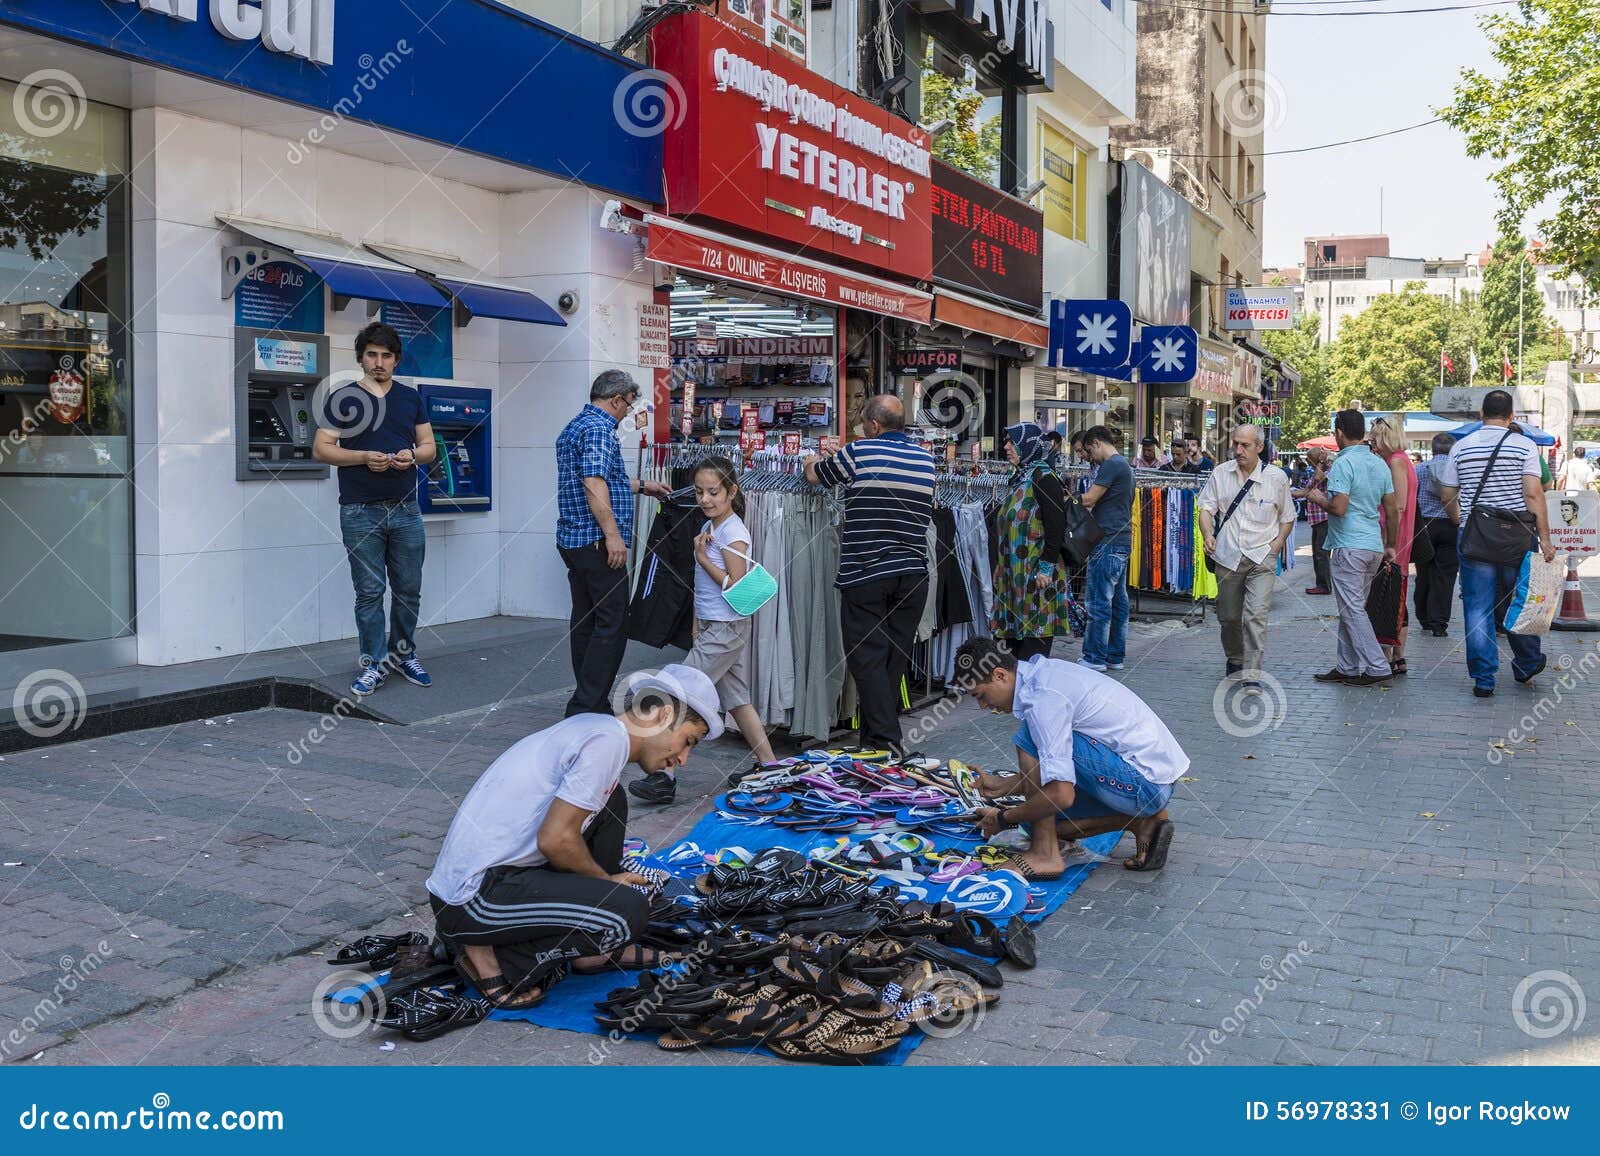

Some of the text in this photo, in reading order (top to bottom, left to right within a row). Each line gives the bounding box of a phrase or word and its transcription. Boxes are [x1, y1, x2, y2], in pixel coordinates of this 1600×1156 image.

[972, 203, 1038, 256] PANTOLON
[990, 244, 1007, 277] TL
[246, 266, 304, 288] ele24plus
[701, 246, 723, 269] 7/24
[727, 253, 766, 280] ONLINE
[780, 267, 827, 298] ALIŞVERİŞ
[1229, 297, 1287, 306] SULTANAHMET
[642, 304, 664, 316] BAYAN
[640, 317, 667, 329] ELEMAN
[895, 351, 958, 366] KUAFÖR
[968, 891, 1000, 902] NIKE
